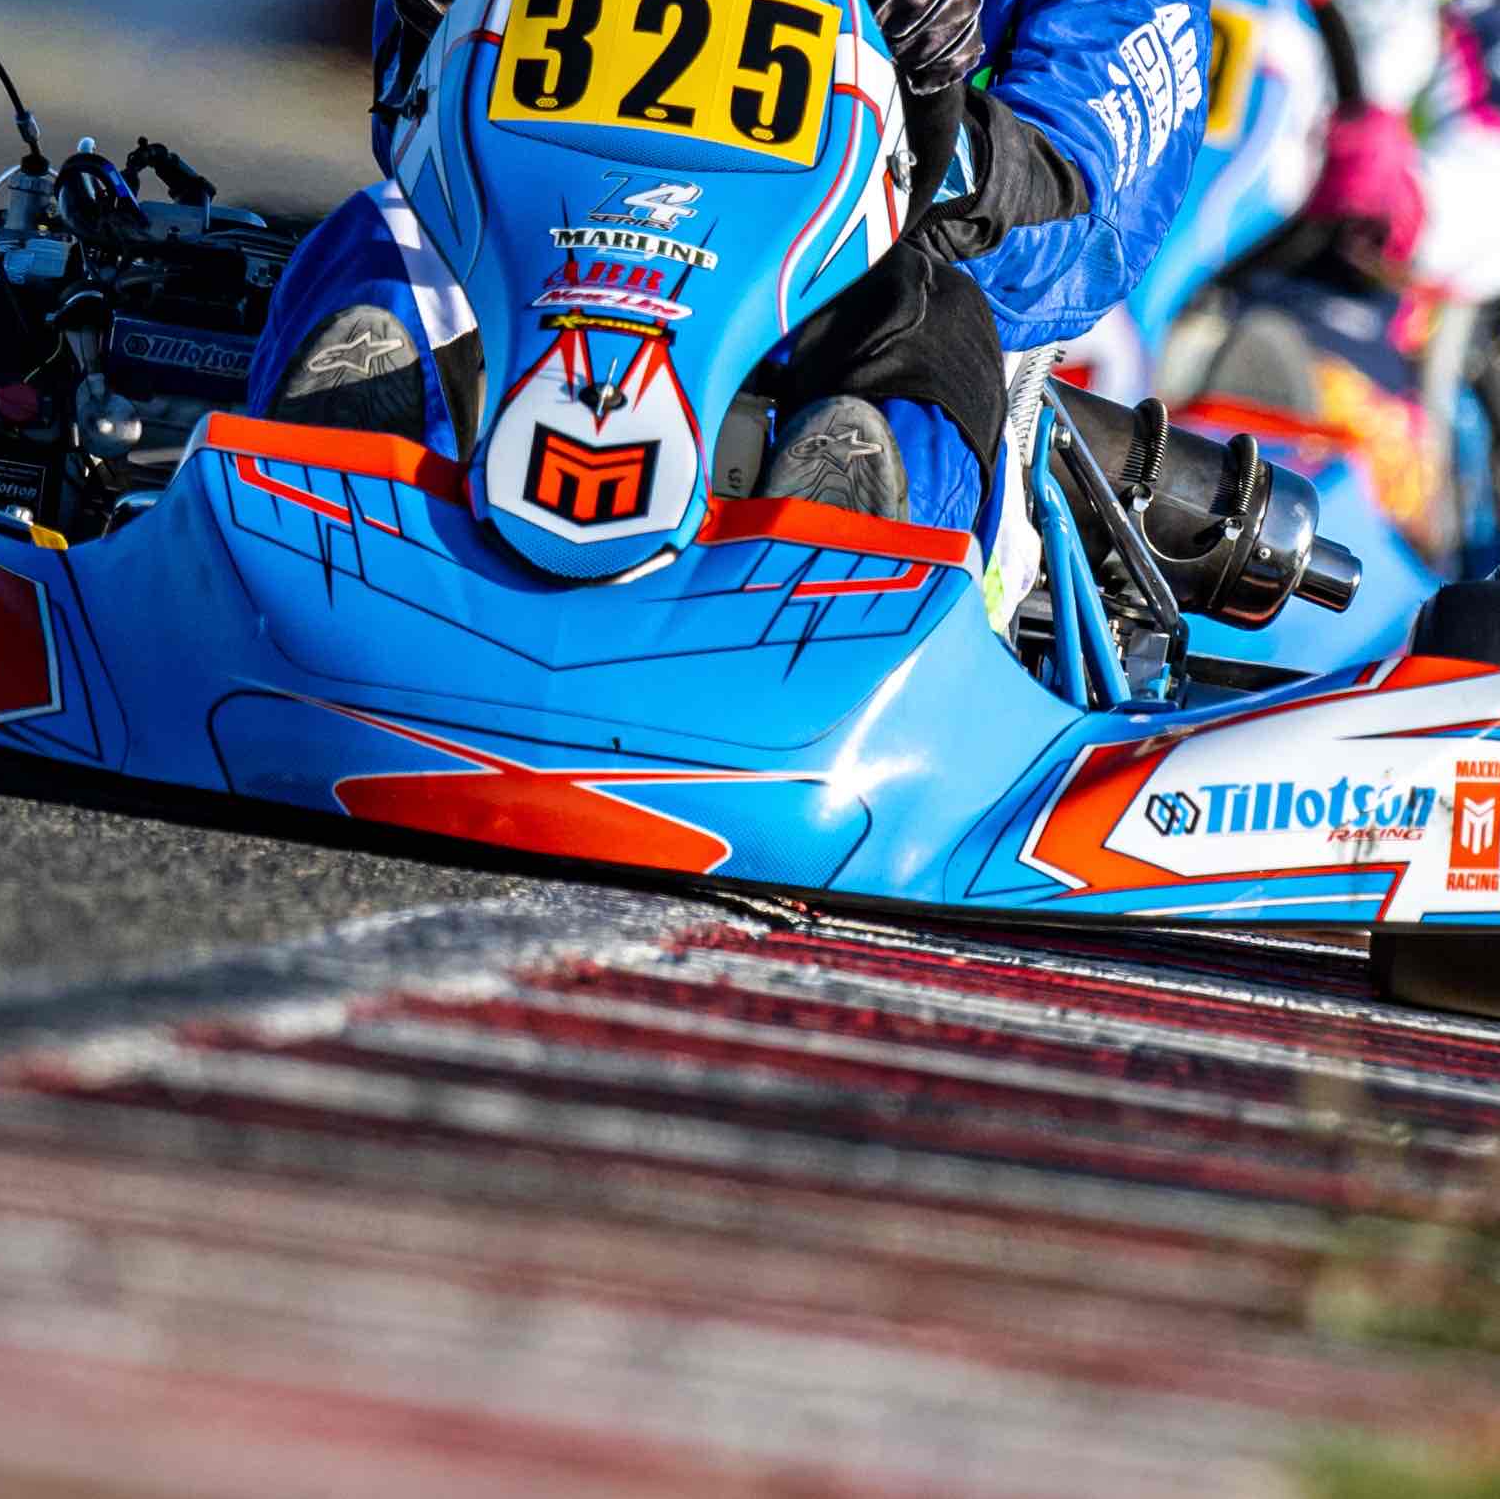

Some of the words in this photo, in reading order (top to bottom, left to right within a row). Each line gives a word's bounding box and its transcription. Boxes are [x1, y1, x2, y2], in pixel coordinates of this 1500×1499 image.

[588, 214, 677, 231] SERIES
[543, 261, 665, 296] ABR
[1198, 775, 1436, 834] Tillotson
[1326, 826, 1425, 843] RACING
[1446, 872, 1499, 891] RACING
